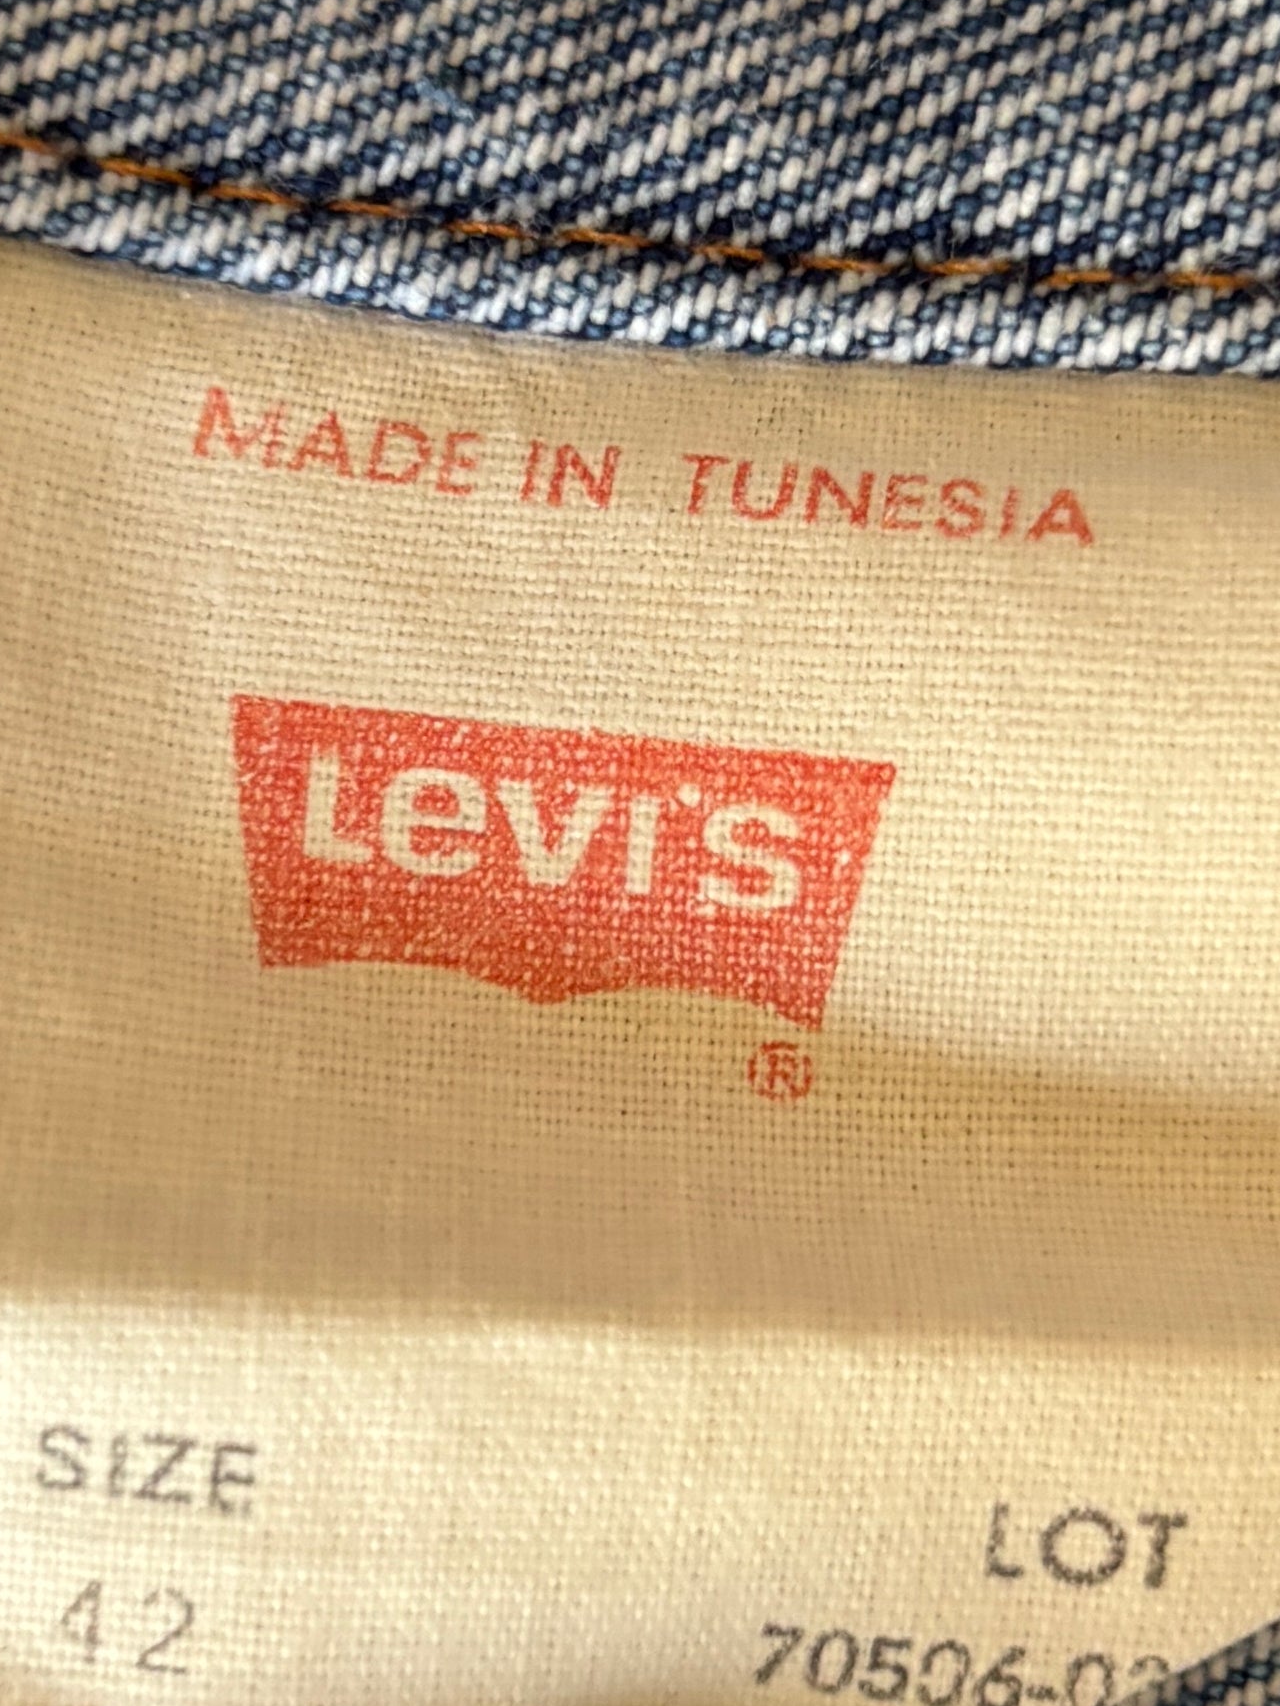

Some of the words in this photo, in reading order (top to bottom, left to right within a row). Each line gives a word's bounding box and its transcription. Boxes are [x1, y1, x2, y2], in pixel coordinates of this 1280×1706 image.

[192, 385, 479, 496] MADE
[520, 440, 621, 508] IN
[683, 453, 1094, 545] TUNESIA
[36, 1424, 256, 1515] SIZE
[984, 1502, 1188, 1588] LOT
[60, 1580, 195, 1674] 42
